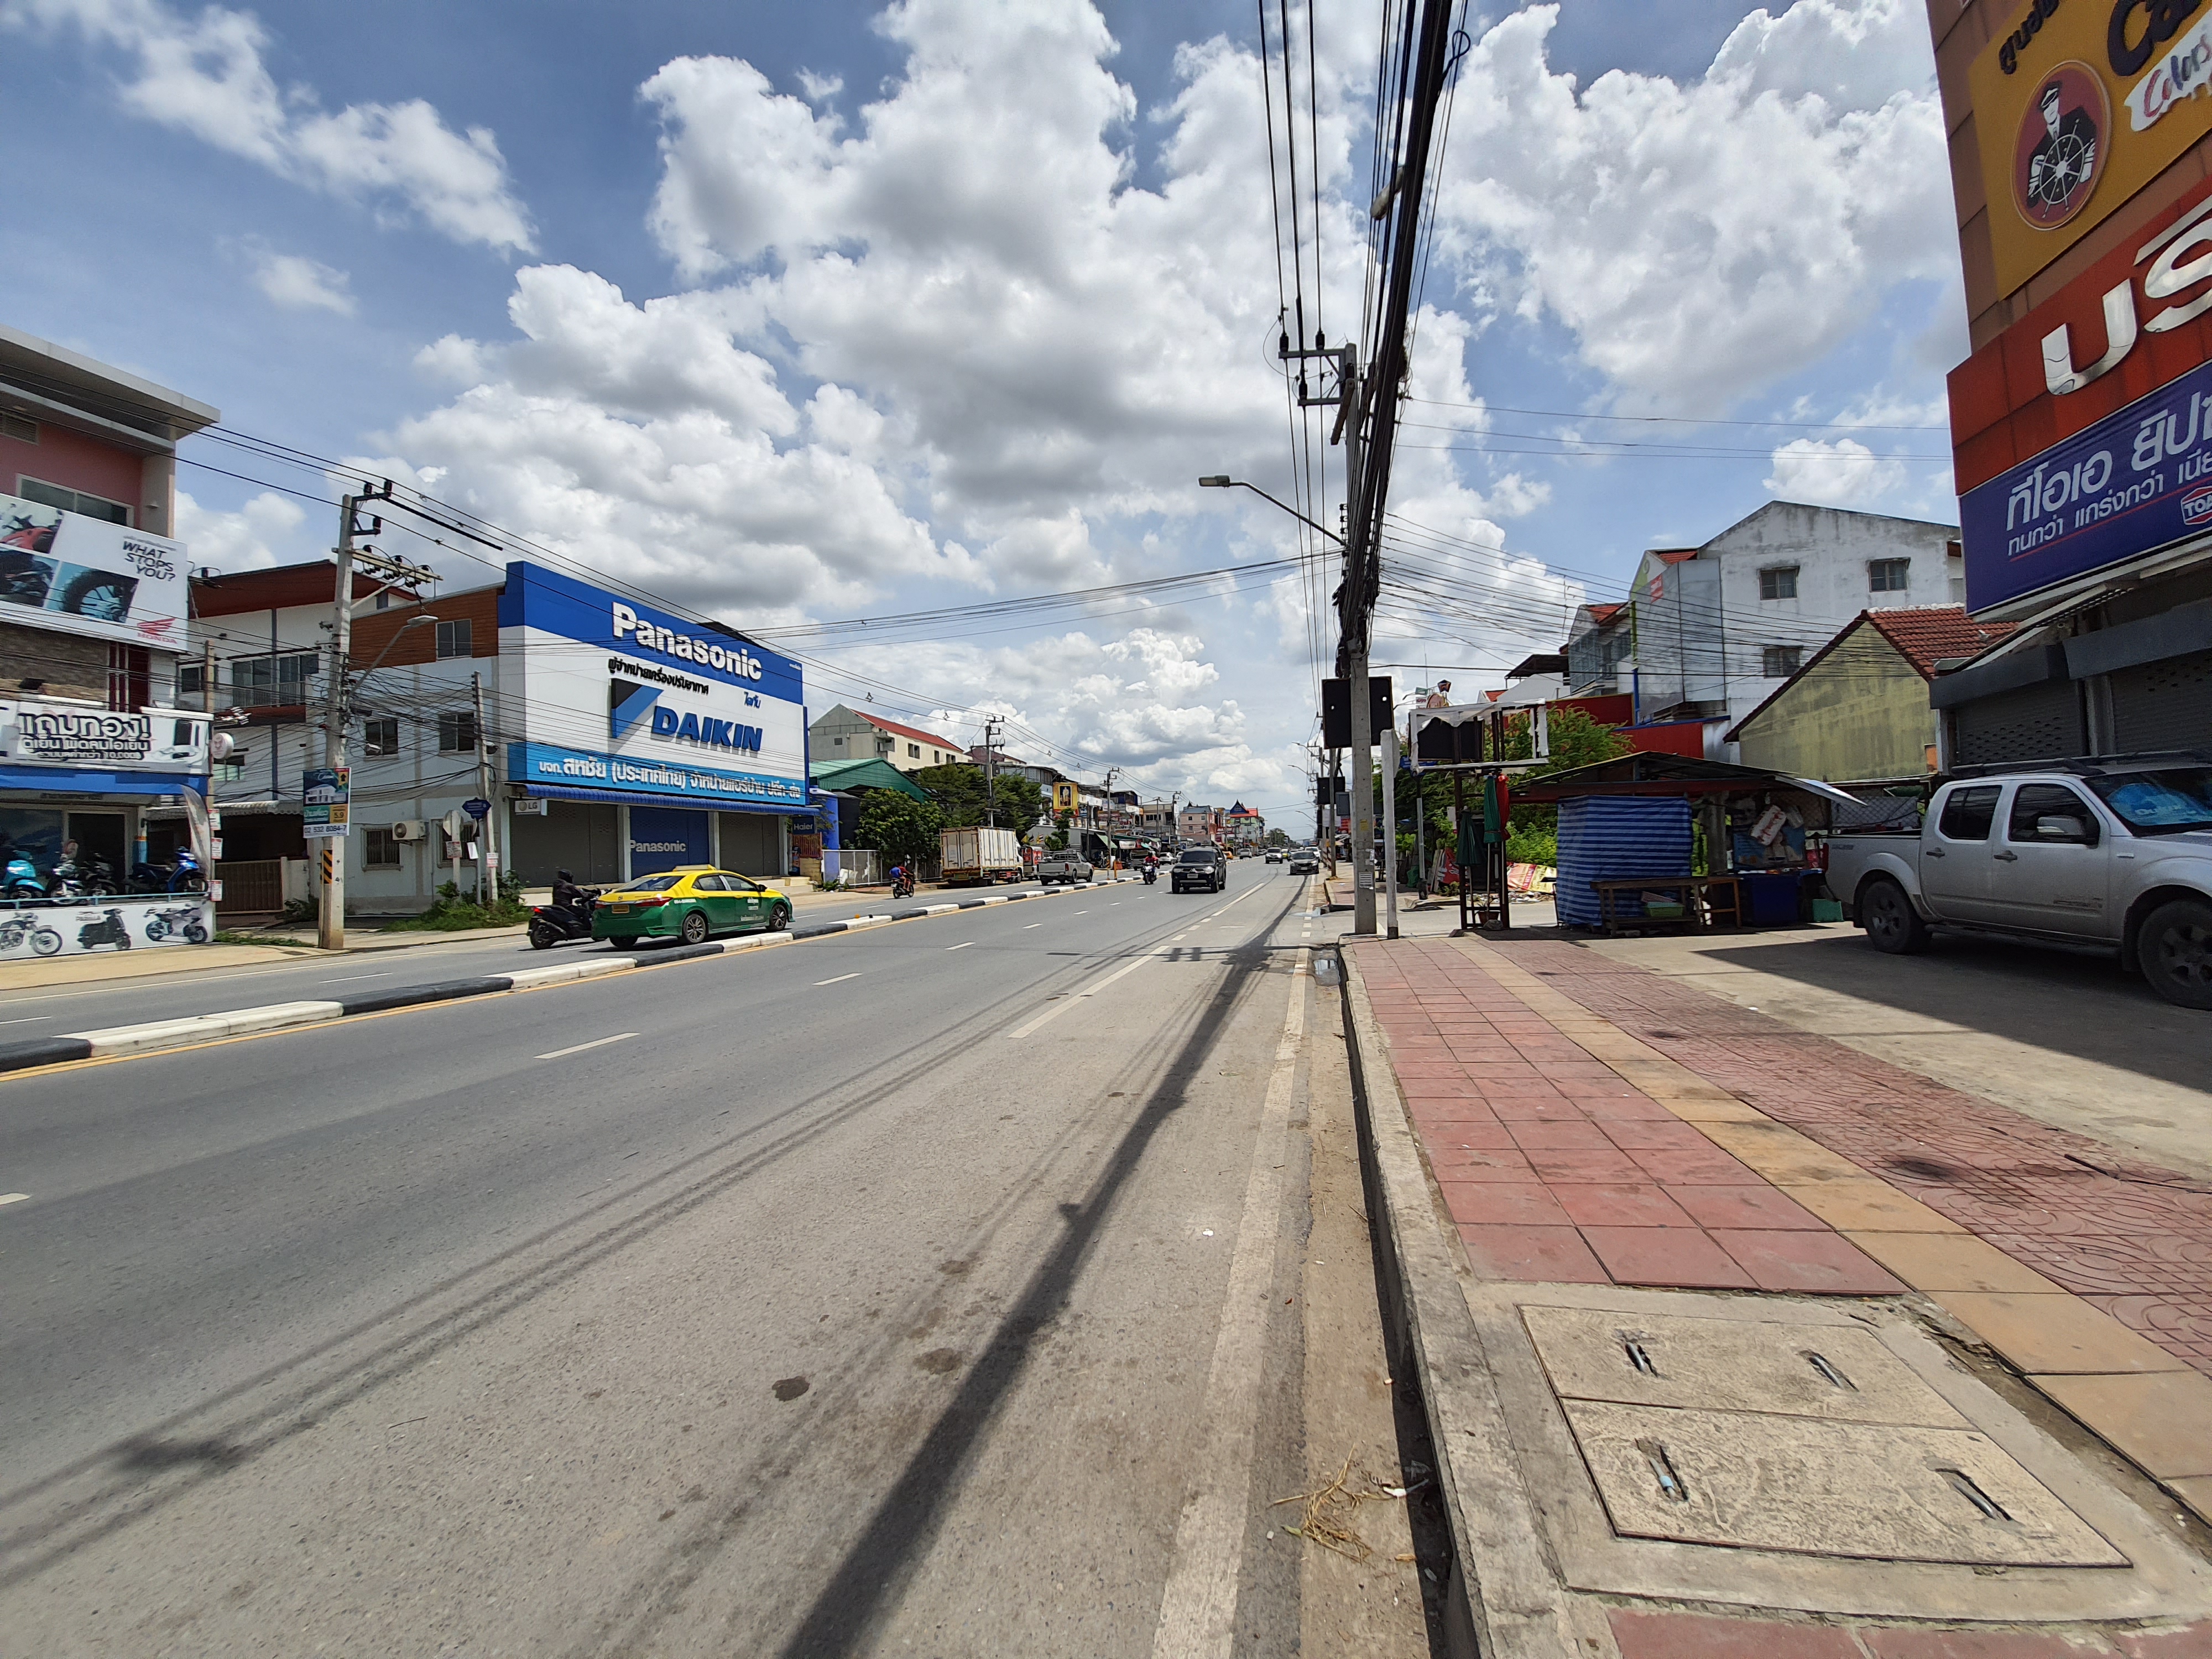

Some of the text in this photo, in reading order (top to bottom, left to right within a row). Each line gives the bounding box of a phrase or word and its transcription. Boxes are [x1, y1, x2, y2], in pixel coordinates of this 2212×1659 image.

[2007, 451, 2112, 531] ทีโอเอ
[2008, 514, 2063, 555] ทนกว่า
[2075, 469, 2163, 528] แกร่งกว่า
[123, 541, 167, 559] WHAT
[124, 552, 174, 572] STOPS
[136, 565, 176, 582] YOU?
[138, 632, 178, 644] HONDA
[612, 602, 762, 681] Panasonic
[651, 706, 763, 752] DAIKIN
[612, 761, 686, 789] (ประเทศไทย)
[630, 839, 686, 853] Panasonic
